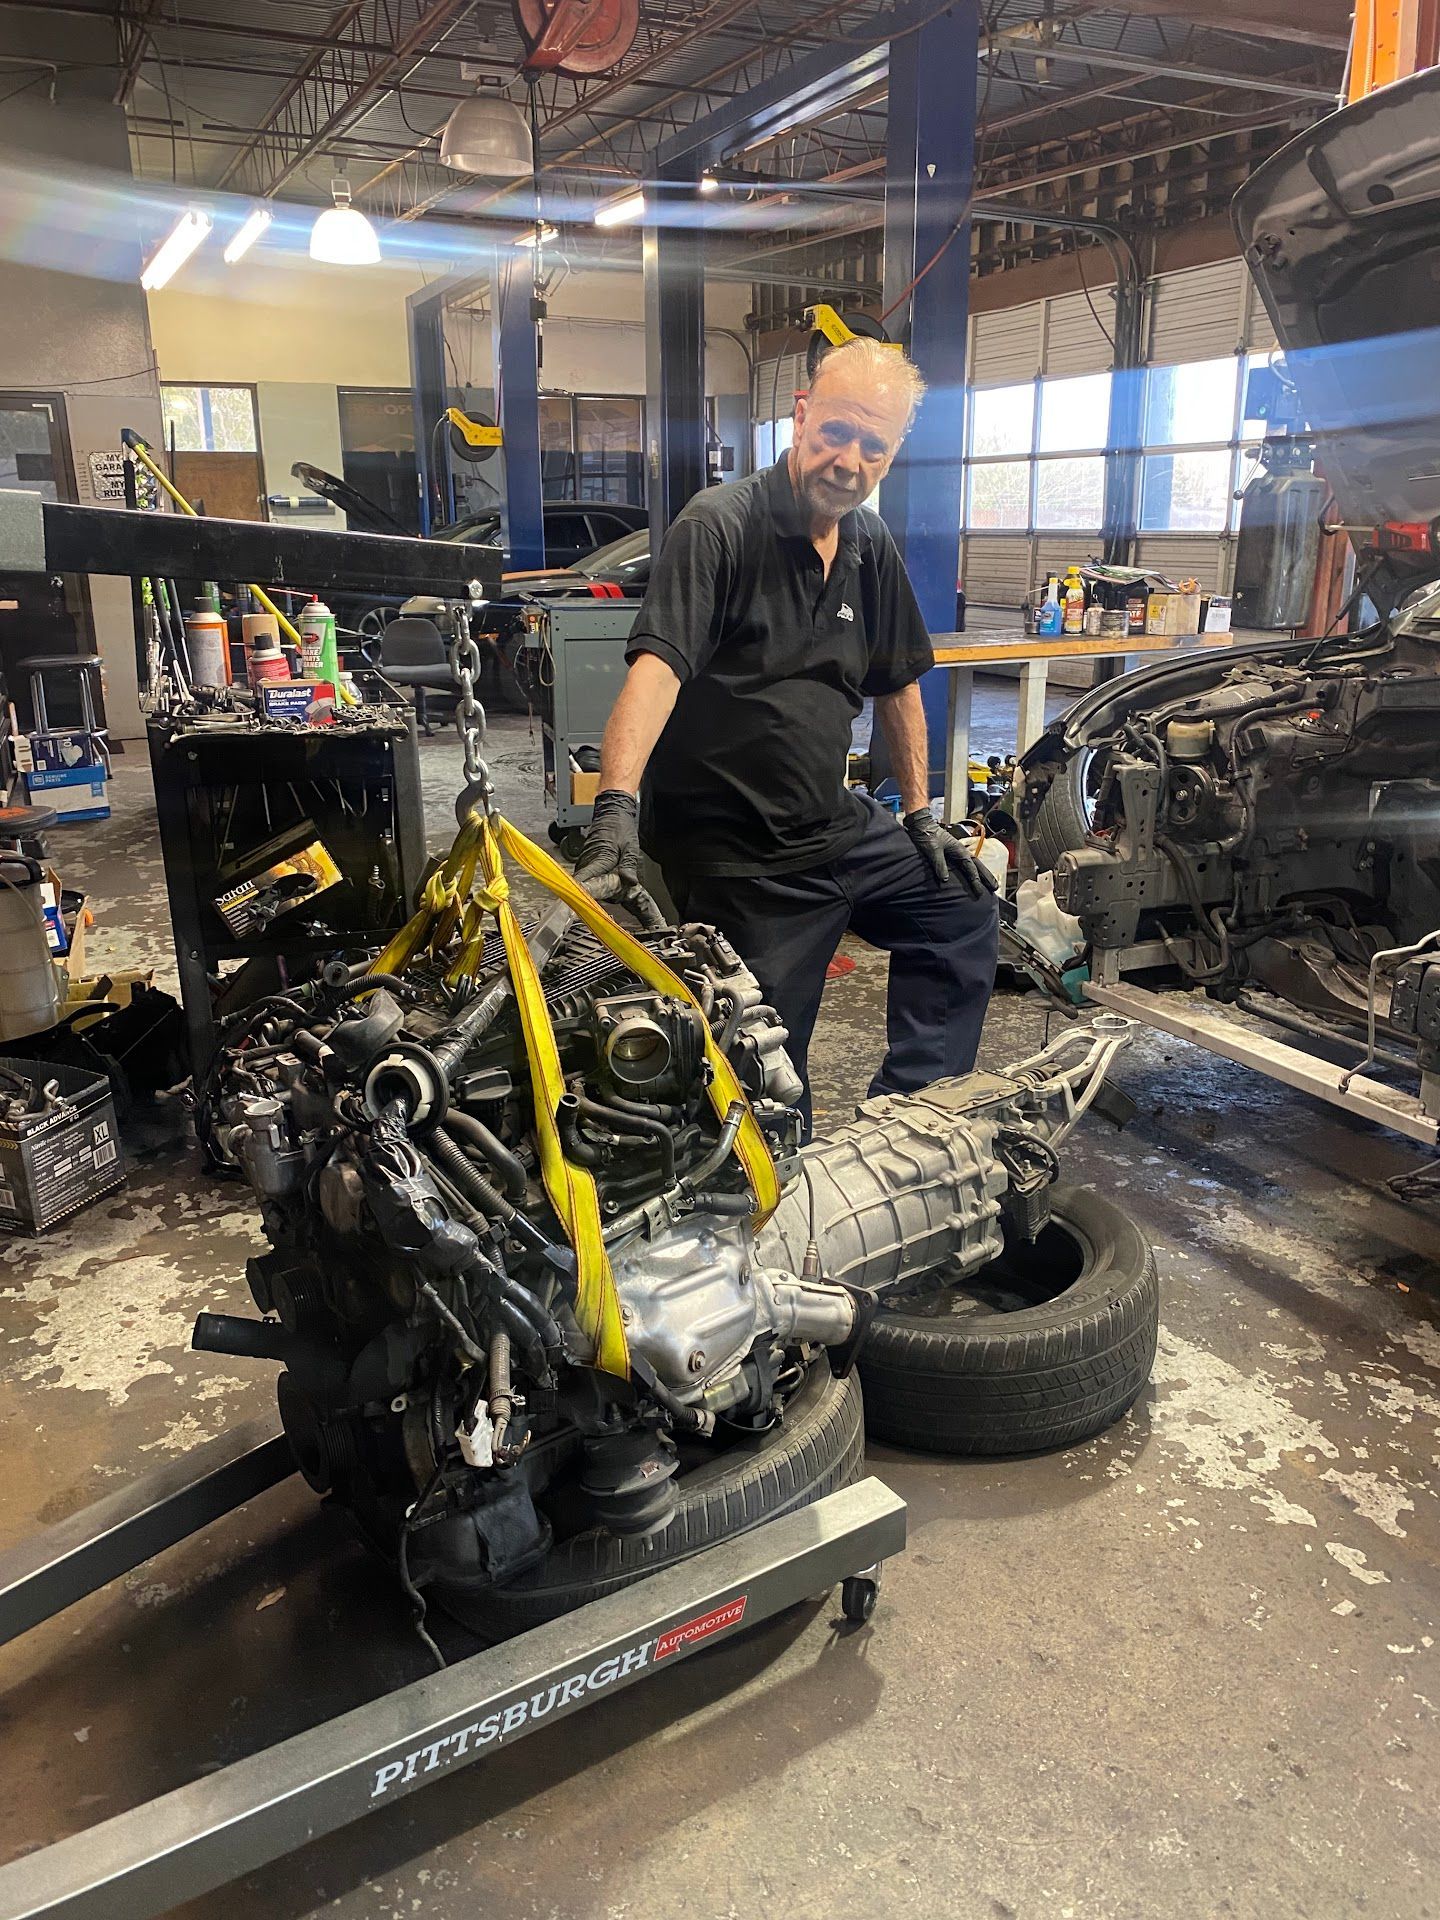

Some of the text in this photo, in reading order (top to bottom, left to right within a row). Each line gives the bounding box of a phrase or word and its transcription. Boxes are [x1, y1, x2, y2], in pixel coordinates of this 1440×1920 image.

[106, 454, 120, 462] MY
[95, 463, 123, 471] GARA
[104, 489, 125, 497] RUL
[267, 687, 312, 699] Duralast
[26, 1120, 50, 1137] BLACK
[95, 1124, 109, 1143] XL
[370, 1604, 743, 1798] PITTSBURGH AUTOMOTIVE
